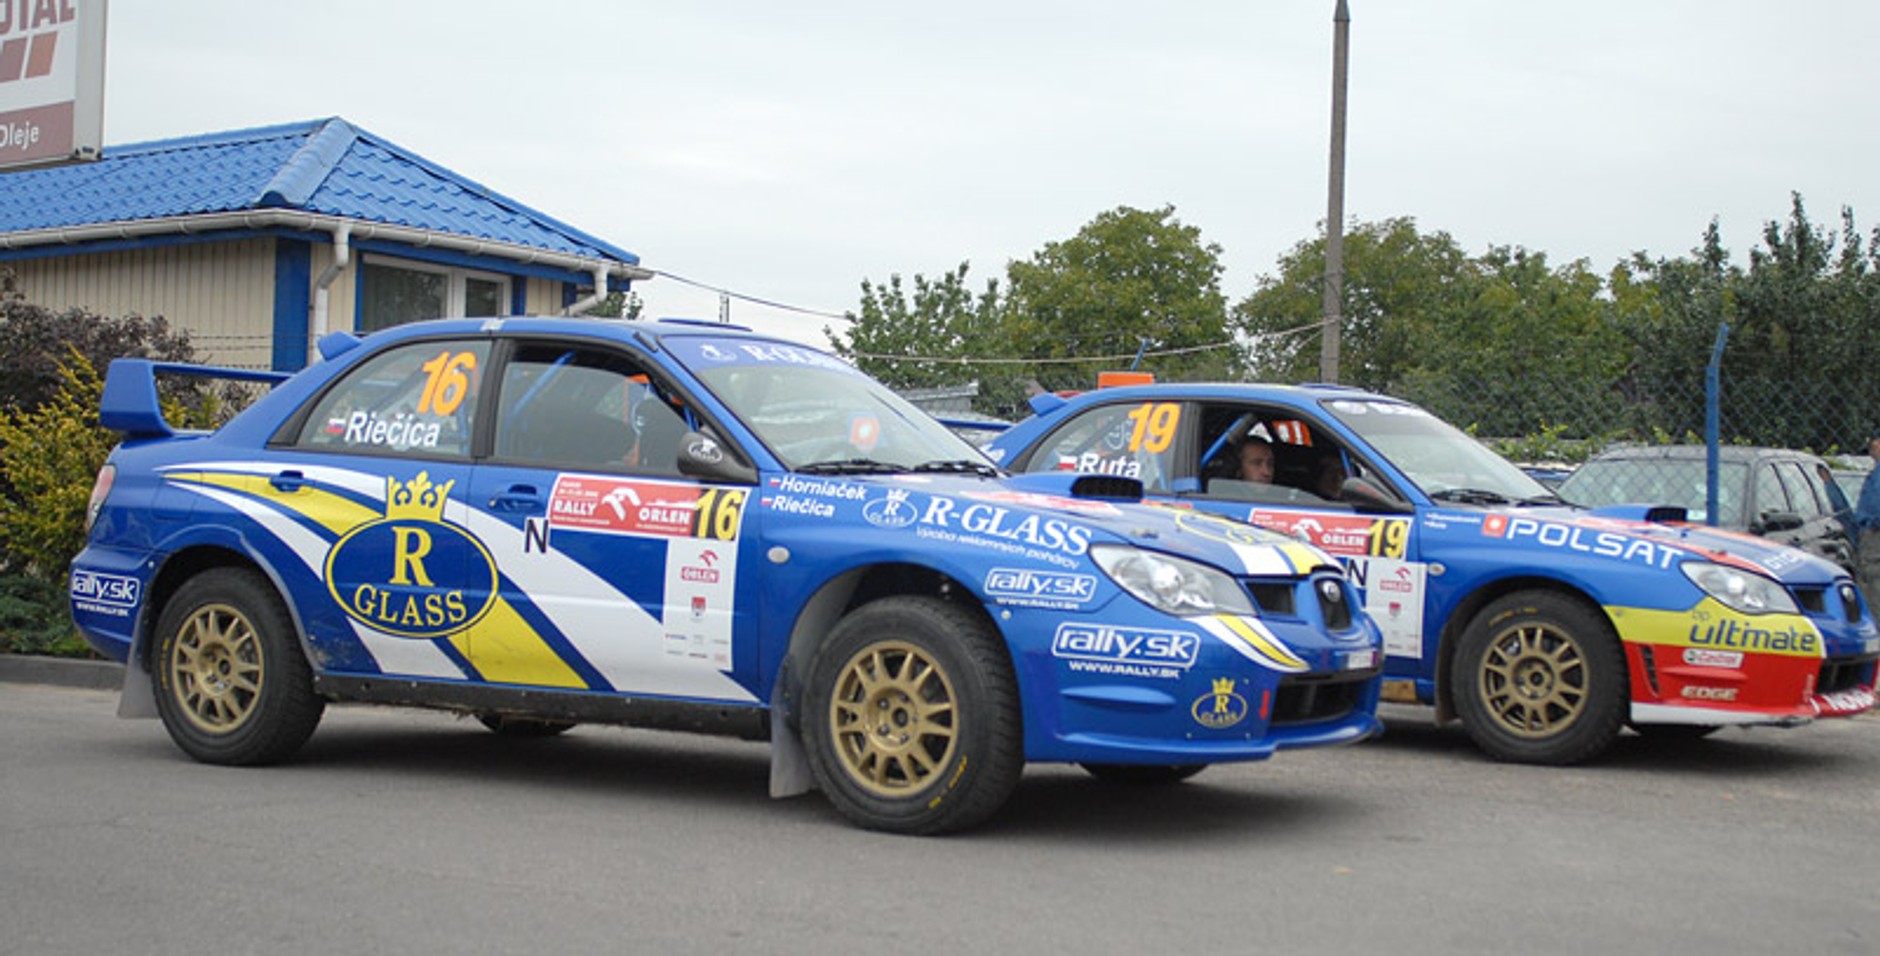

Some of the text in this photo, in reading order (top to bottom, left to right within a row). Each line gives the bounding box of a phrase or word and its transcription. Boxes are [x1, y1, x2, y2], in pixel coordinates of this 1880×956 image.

[417, 352, 475, 415] 16
[344, 411, 440, 447] Riečica
[1128, 402, 1180, 453] 19
[1080, 452, 1141, 477] Ruta
[780, 475, 868, 500] Horniaček
[553, 500, 691, 525] RALLY ORLEN
[696, 489, 742, 541] 16
[771, 495, 835, 517] Riečica
[884, 501, 900, 515] R
[524, 519, 549, 554] N
[920, 495, 1092, 556] R-GLASS
[1322, 533, 1366, 546] ORLEN
[1367, 519, 1405, 557] 19
[389, 526, 434, 587] R
[1506, 518, 1684, 569] POLSAT
[989, 571, 1092, 597] rally.sk
[1348, 559, 1368, 587] N
[354, 583, 468, 626] GLASS
[1059, 628, 1193, 659] rally.sk
[1690, 619, 1816, 652] ultimate
[1215, 695, 1230, 713] R
